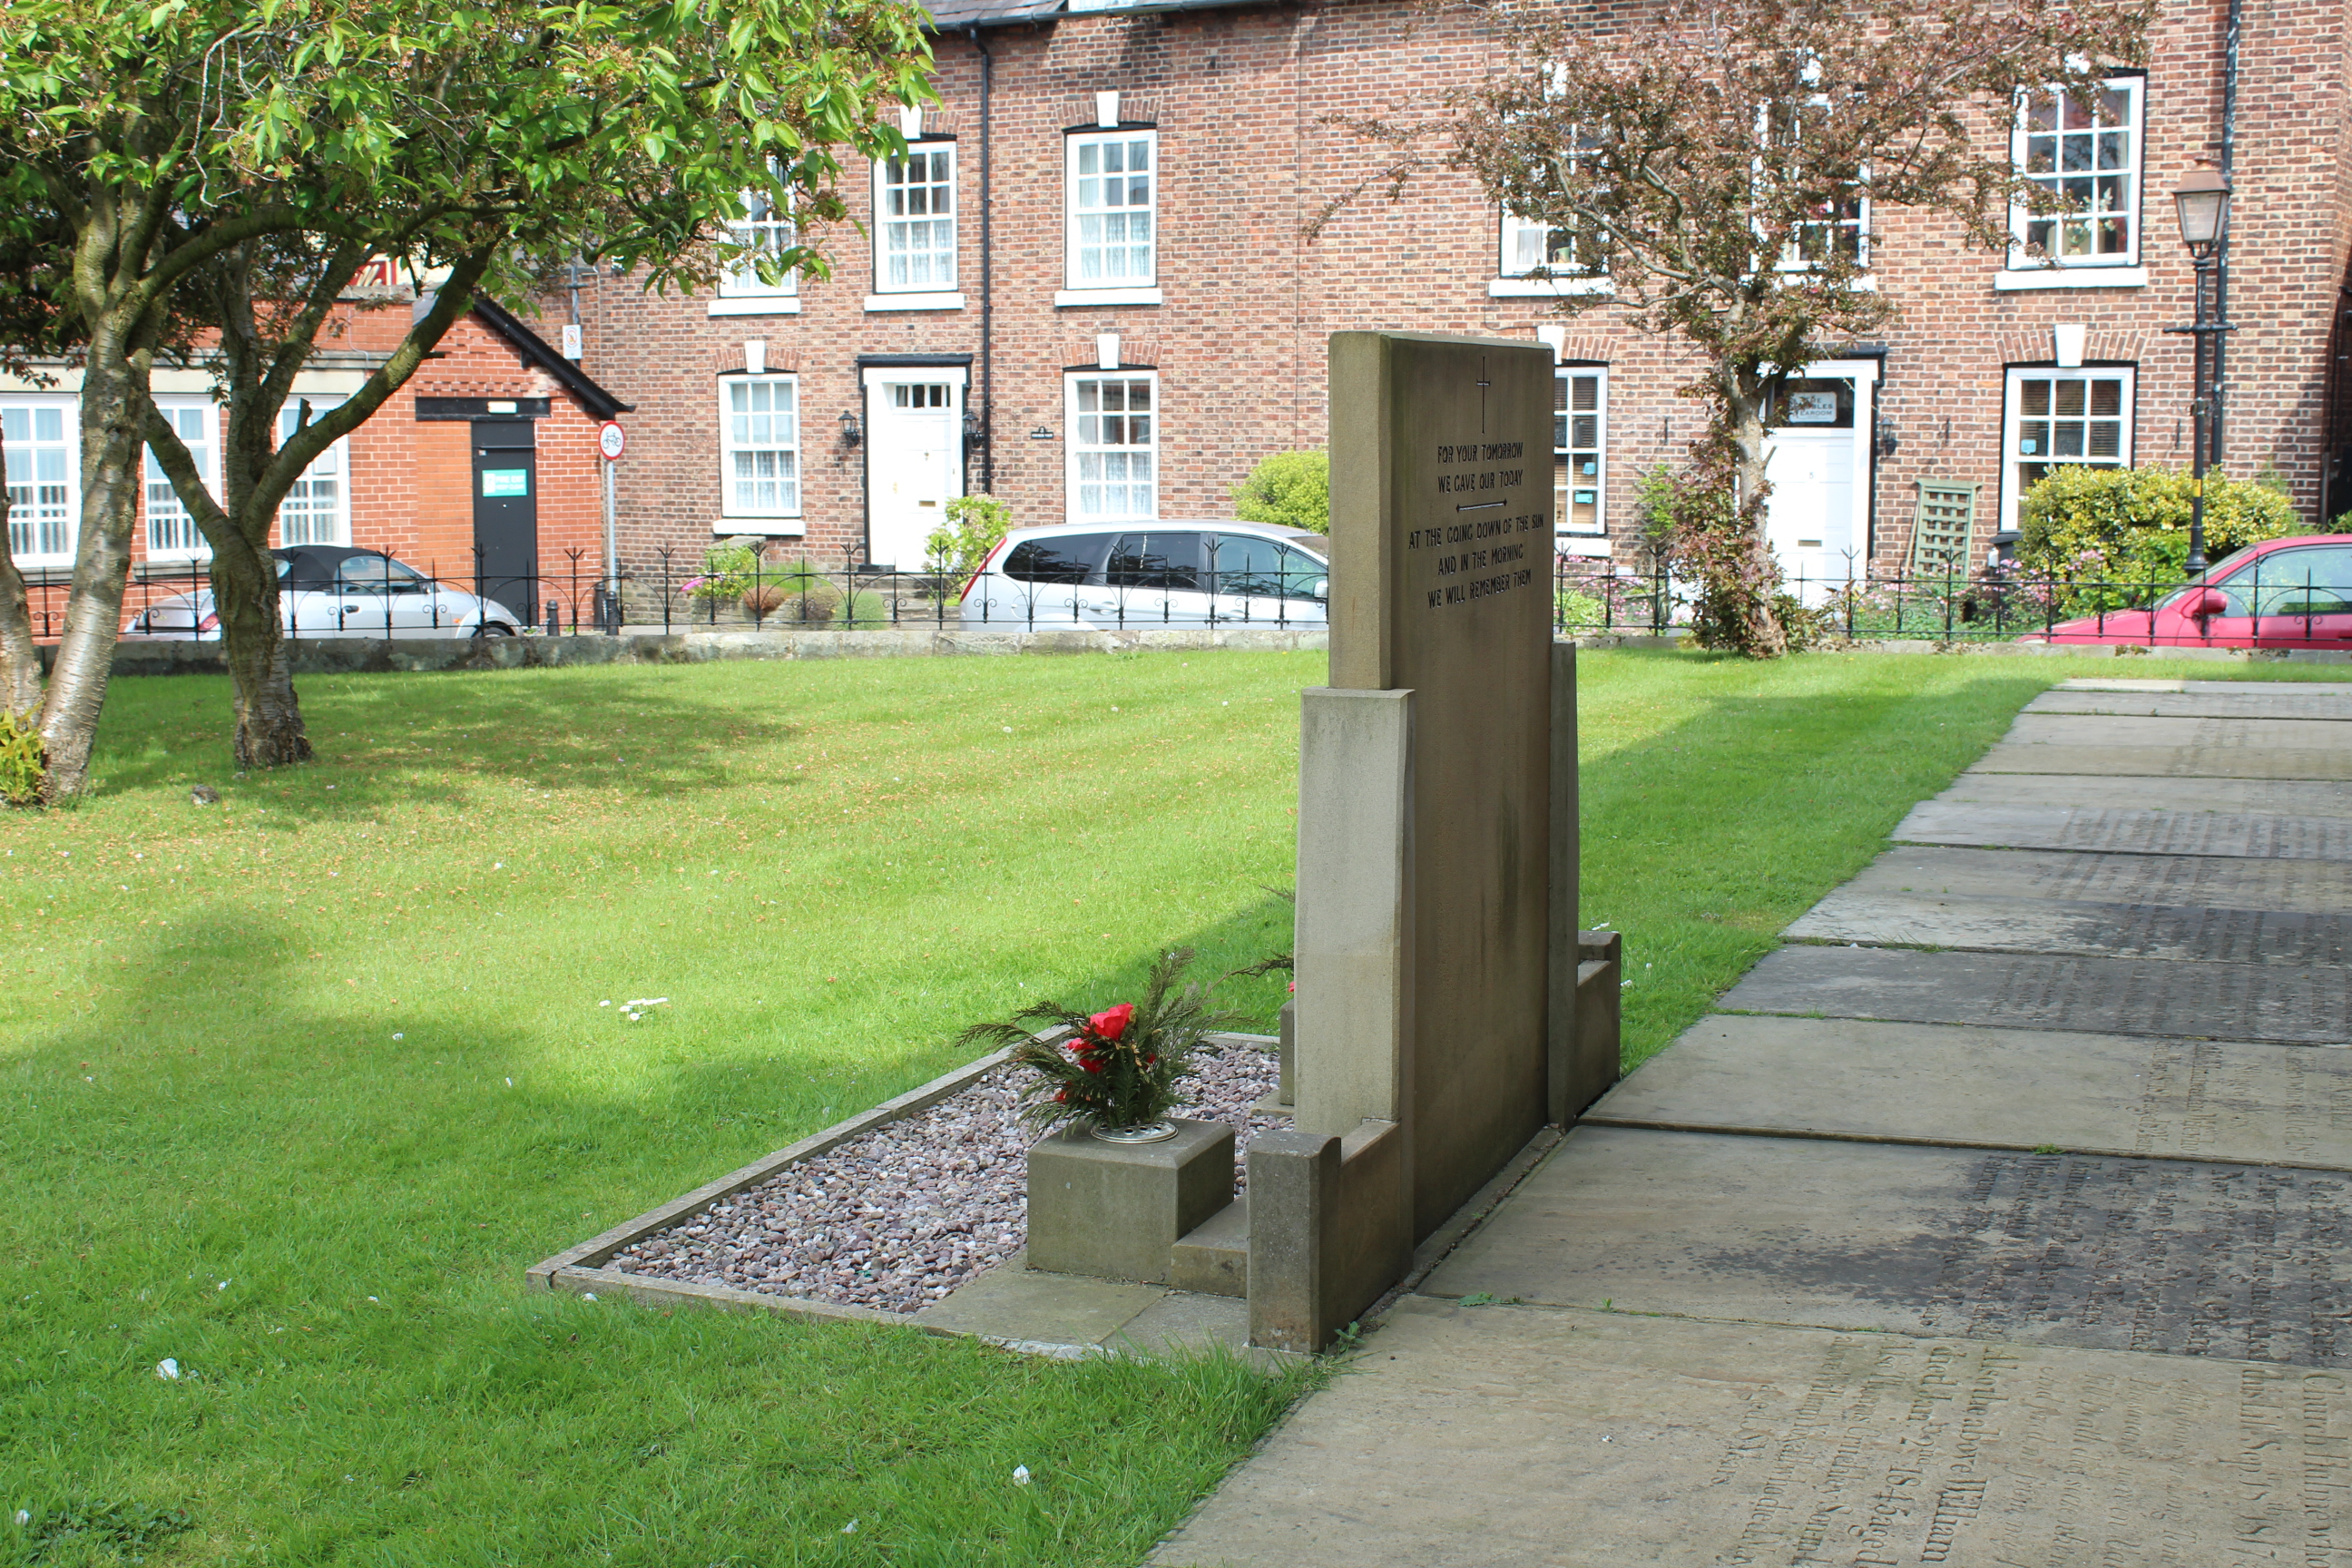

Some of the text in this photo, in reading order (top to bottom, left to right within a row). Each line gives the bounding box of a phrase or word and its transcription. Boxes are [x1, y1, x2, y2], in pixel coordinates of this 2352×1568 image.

[1437, 442, 1524, 464] FOR YOUR TOMORROW
[1437, 469, 1524, 494] WE GAVE OUR TODAY
[1408, 514, 1544, 550] AT THE GOING DOWN OF THE SUN
[1437, 544, 1524, 576] AND IN THE MORNING
[1427, 568, 1532, 609] WE WILL REMEMBER THEM
